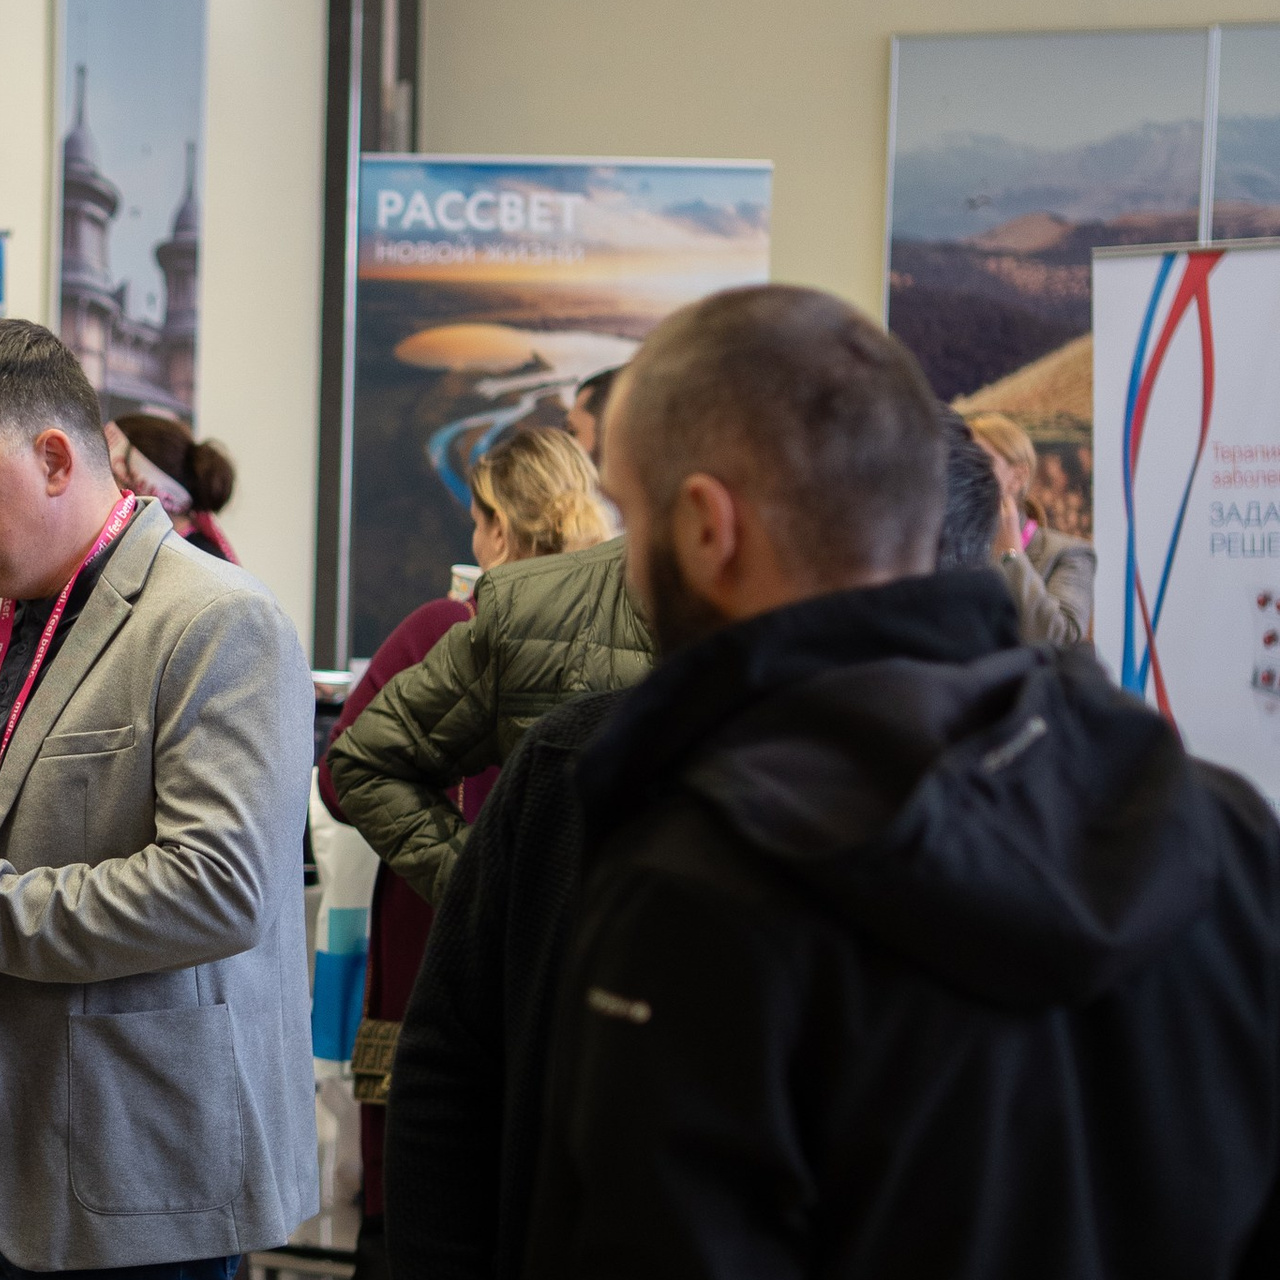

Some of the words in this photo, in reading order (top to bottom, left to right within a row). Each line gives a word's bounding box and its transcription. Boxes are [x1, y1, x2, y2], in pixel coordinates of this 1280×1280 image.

[377, 190, 586, 232] РАССВЕТ
[375, 236, 475, 264] НОВОЙ
[1213, 466, 1280, 490] заболе
[1210, 501, 1280, 529] ЗАДА
